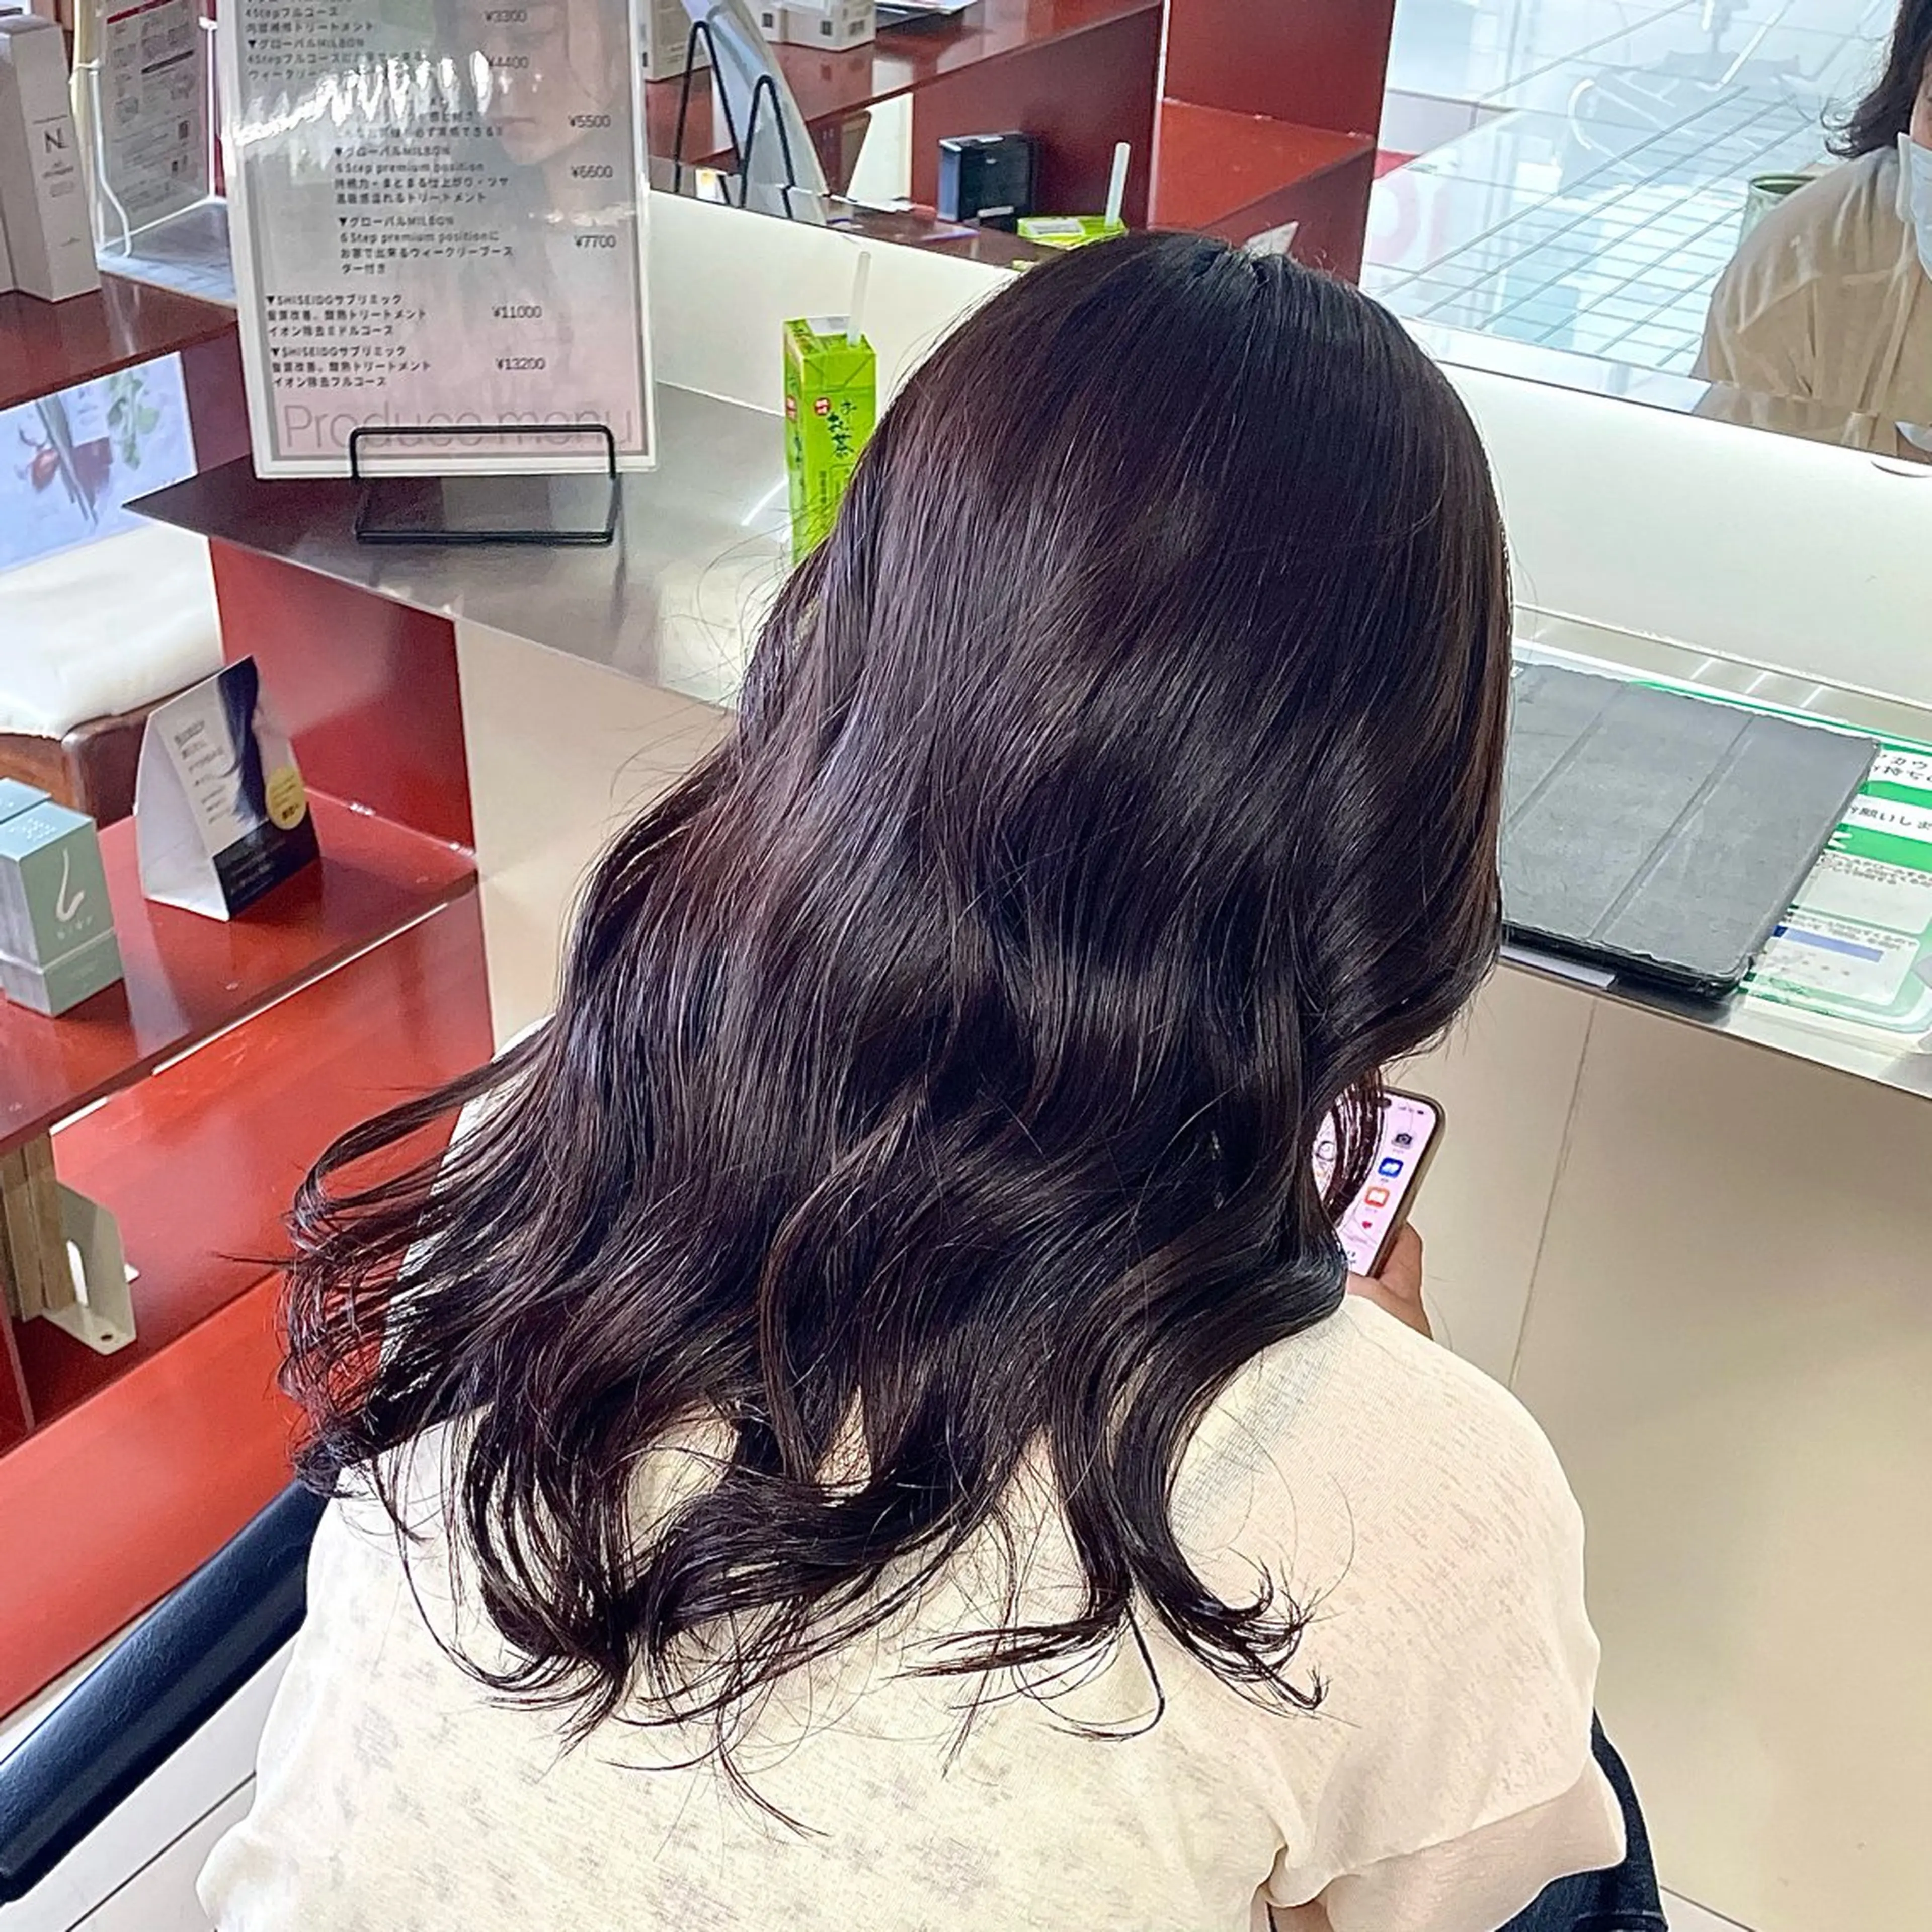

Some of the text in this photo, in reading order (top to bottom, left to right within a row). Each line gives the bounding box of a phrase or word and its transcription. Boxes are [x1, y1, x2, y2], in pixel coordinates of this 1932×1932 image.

[568, 115, 611, 128] ¥5500
[574, 234, 616, 248] ¥7700
[493, 305, 542, 318] ¥11000
[496, 357, 546, 370] ¥13200
[283, 401, 634, 449] Produce menu
